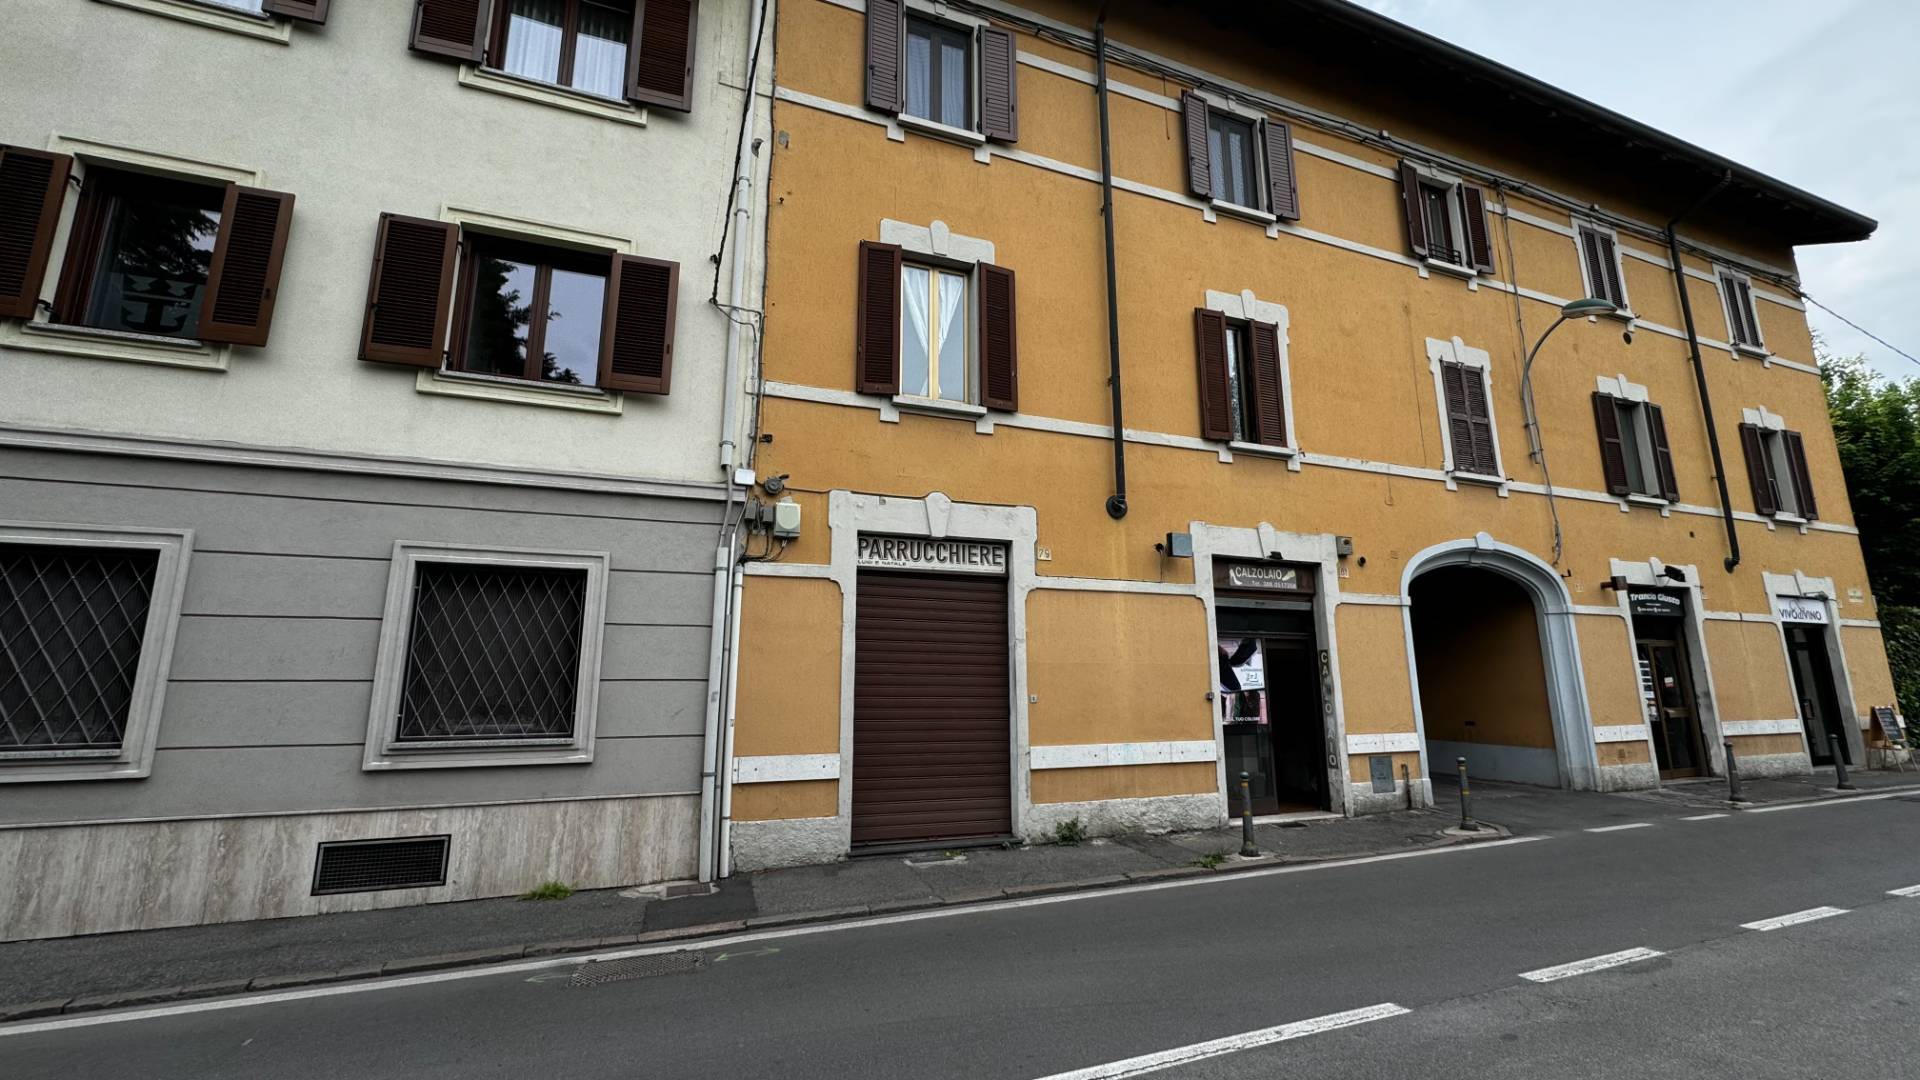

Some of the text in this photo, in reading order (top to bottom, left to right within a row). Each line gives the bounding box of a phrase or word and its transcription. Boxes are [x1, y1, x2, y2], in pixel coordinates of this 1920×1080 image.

[858, 537, 1004, 566] PARRUCCHIERE
[1235, 566, 1282, 580] CALZOLAIO
[1630, 593, 1680, 605] Trancio Giusto
